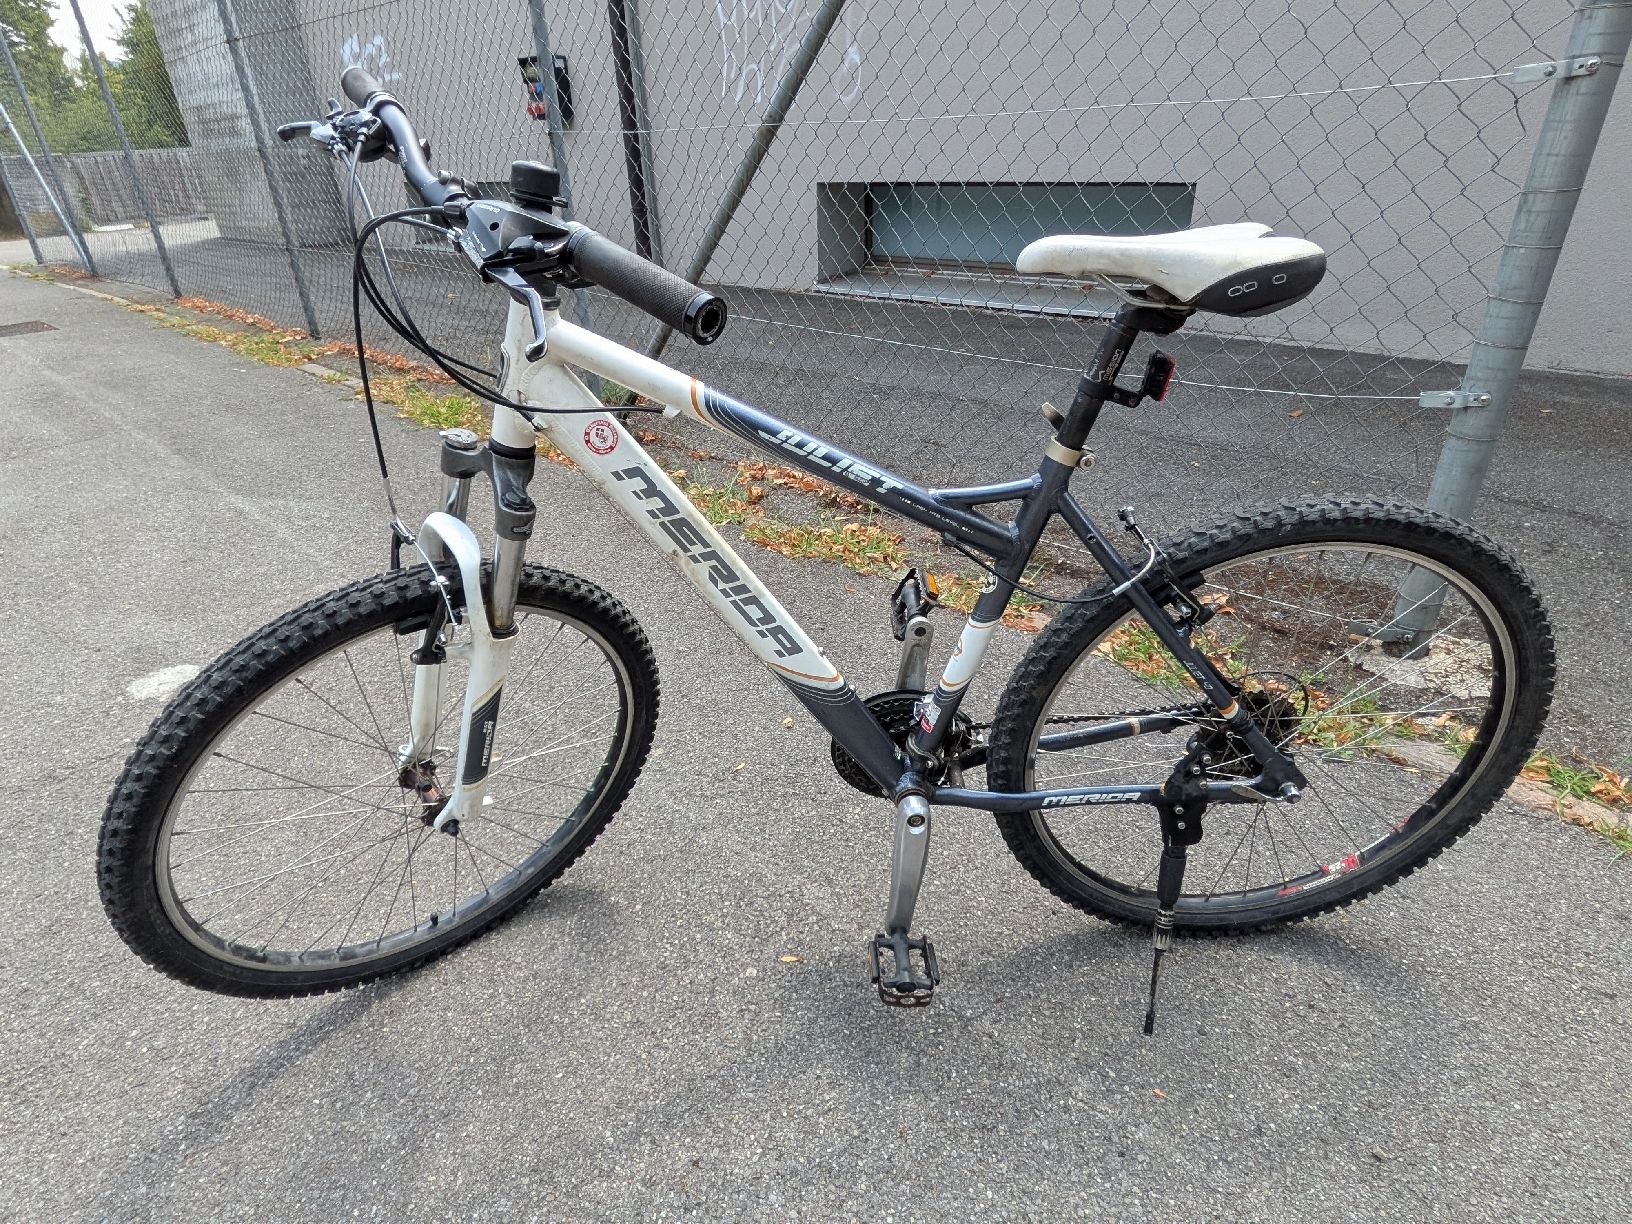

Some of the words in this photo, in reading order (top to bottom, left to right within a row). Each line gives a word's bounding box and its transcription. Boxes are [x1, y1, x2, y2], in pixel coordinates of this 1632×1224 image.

[757, 428, 905, 495] JULIET
[609, 465, 804, 659] MERIDA
[481, 720, 495, 767] MERIDA
[1041, 792, 1141, 806] MERIDA
